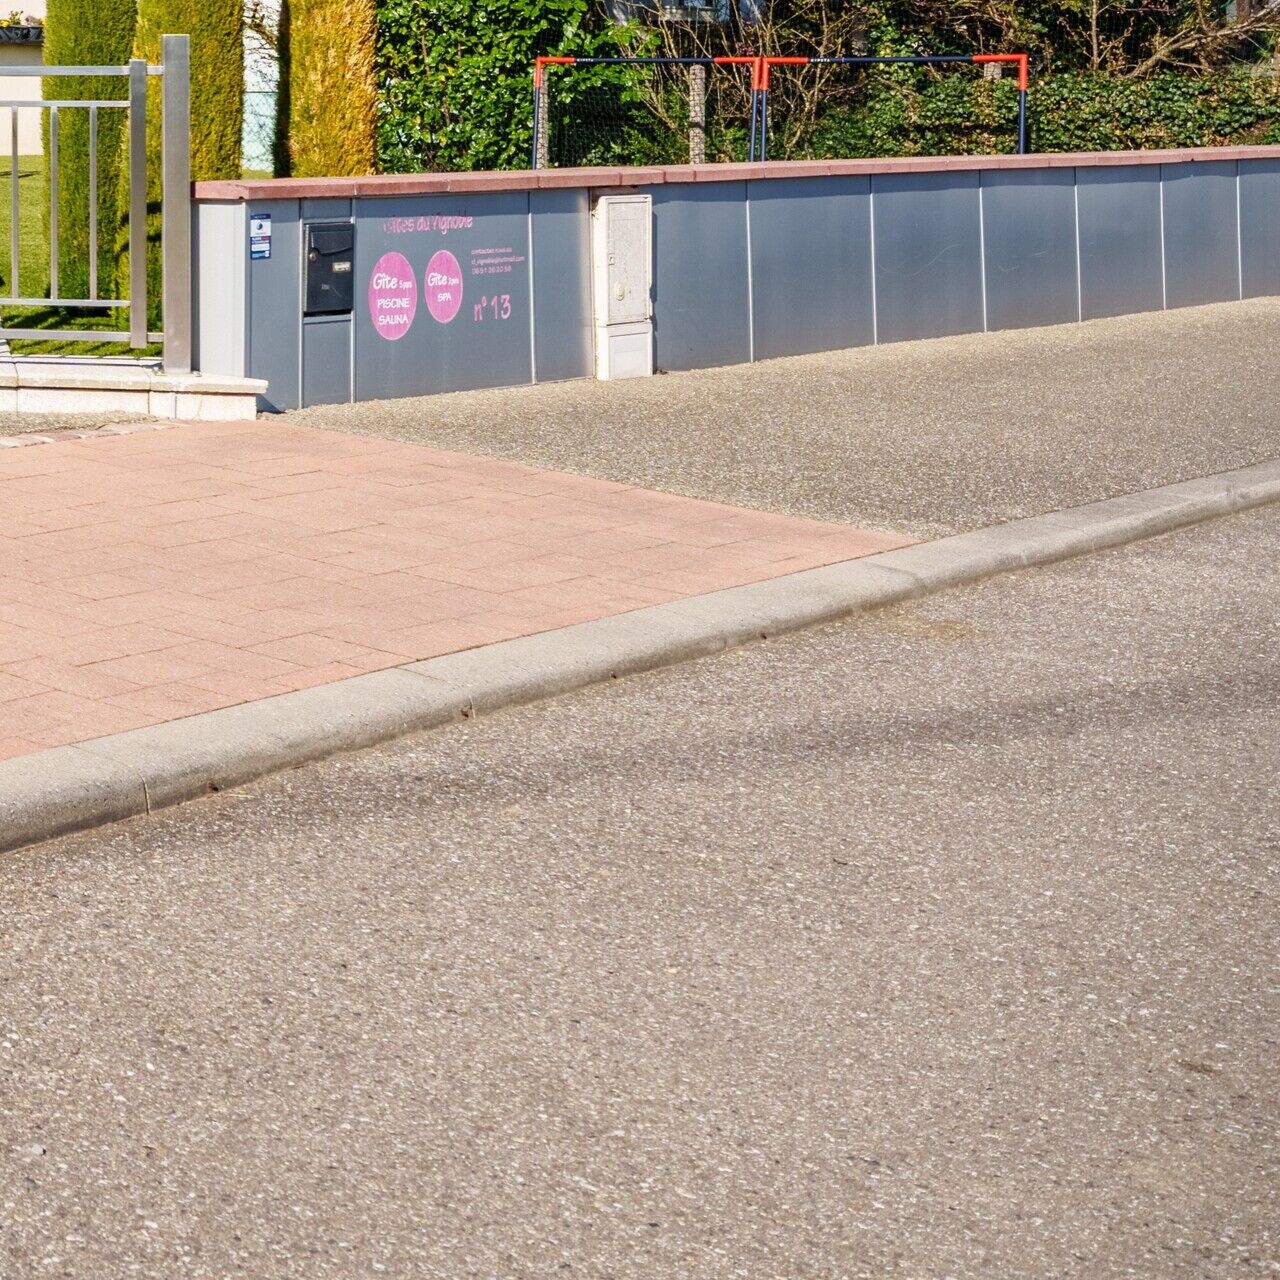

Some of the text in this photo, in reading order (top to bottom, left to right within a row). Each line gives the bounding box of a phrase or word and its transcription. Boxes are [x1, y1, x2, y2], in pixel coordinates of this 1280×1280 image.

[373, 273, 398, 290] Gîte
[427, 271, 448, 287] Gîte
[377, 297, 411, 309] PISCINE
[437, 292, 452, 303] SPA
[490, 294, 511, 320] 13
[378, 313, 409, 326] SAUNA
